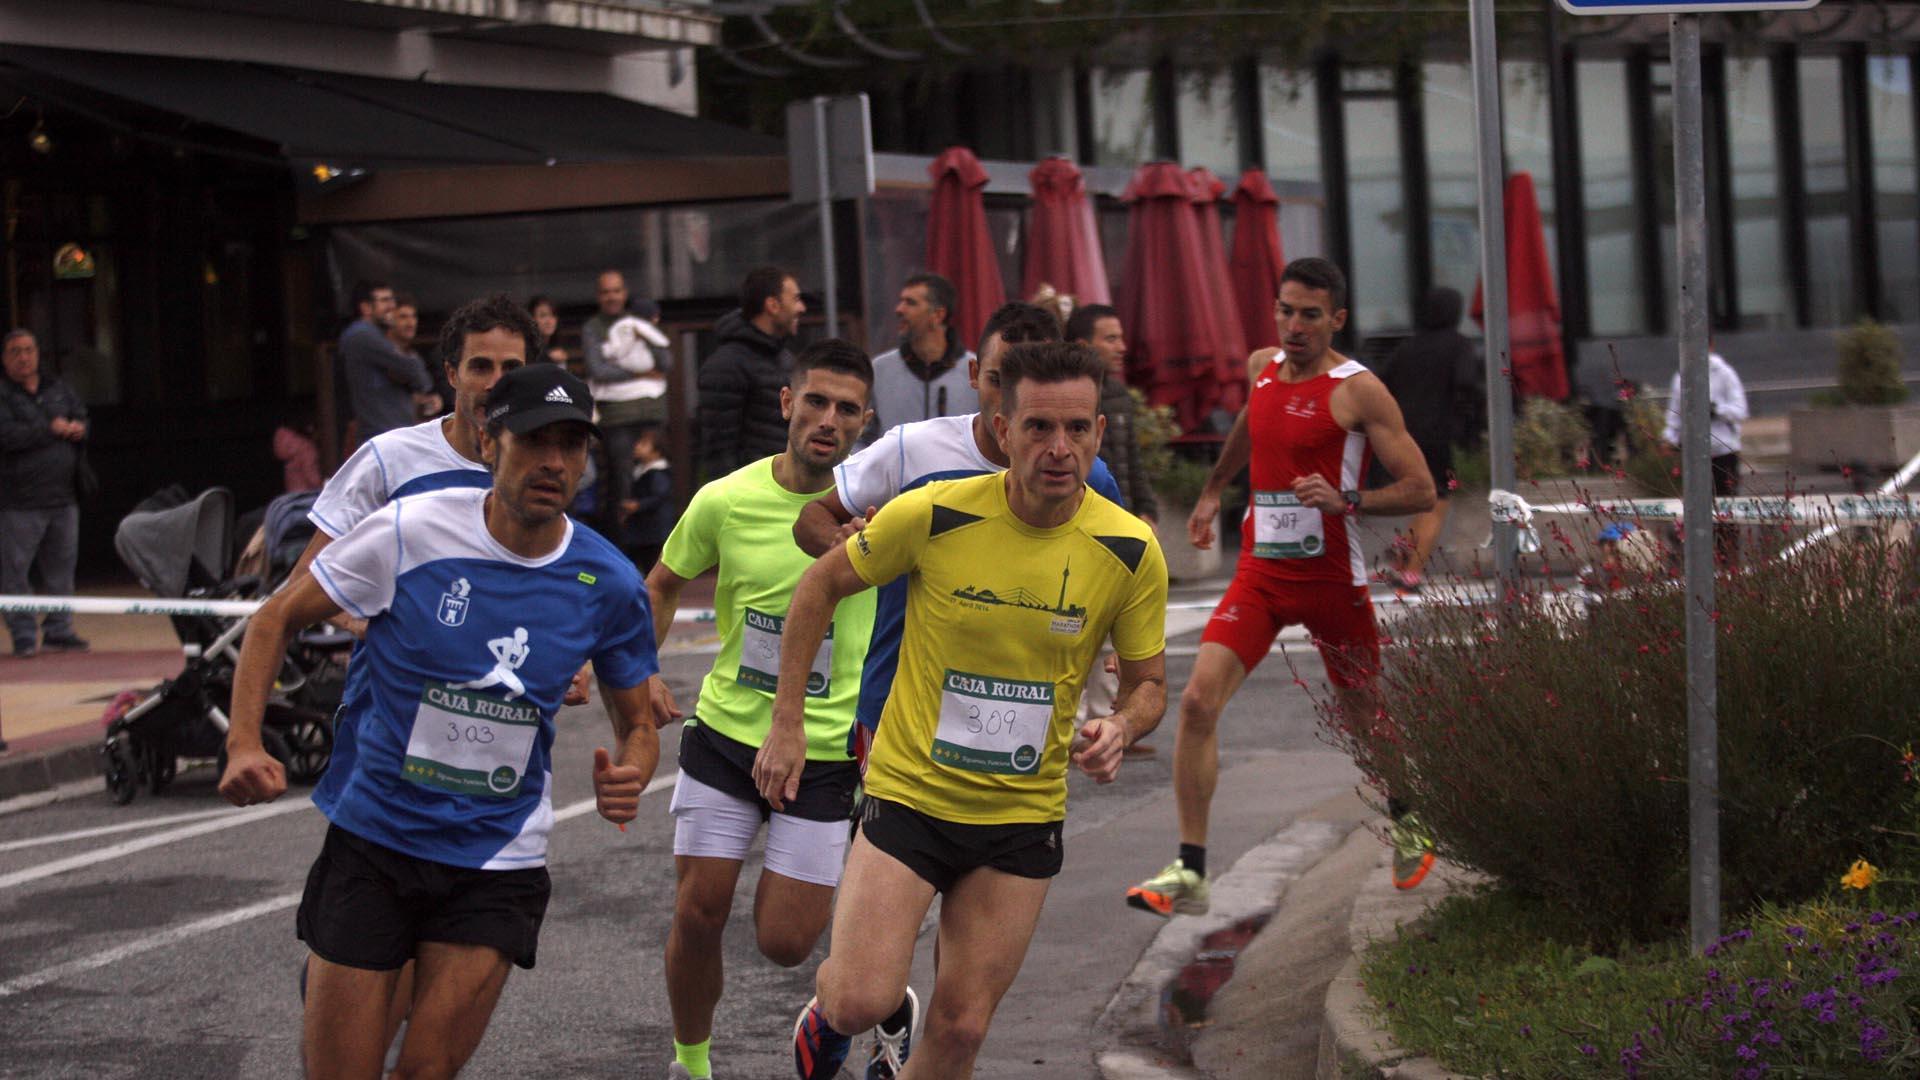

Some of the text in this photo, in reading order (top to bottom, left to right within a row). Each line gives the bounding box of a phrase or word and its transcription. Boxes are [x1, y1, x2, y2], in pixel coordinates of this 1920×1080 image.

[545, 395, 573, 404] adidas
[1269, 512, 1300, 530] 307
[747, 612, 777, 630] CAJA
[948, 674, 1051, 700] CAJA RURAL
[428, 687, 536, 722] CAJA RURAL
[967, 704, 1017, 736] 309
[446, 721, 495, 743] 303
